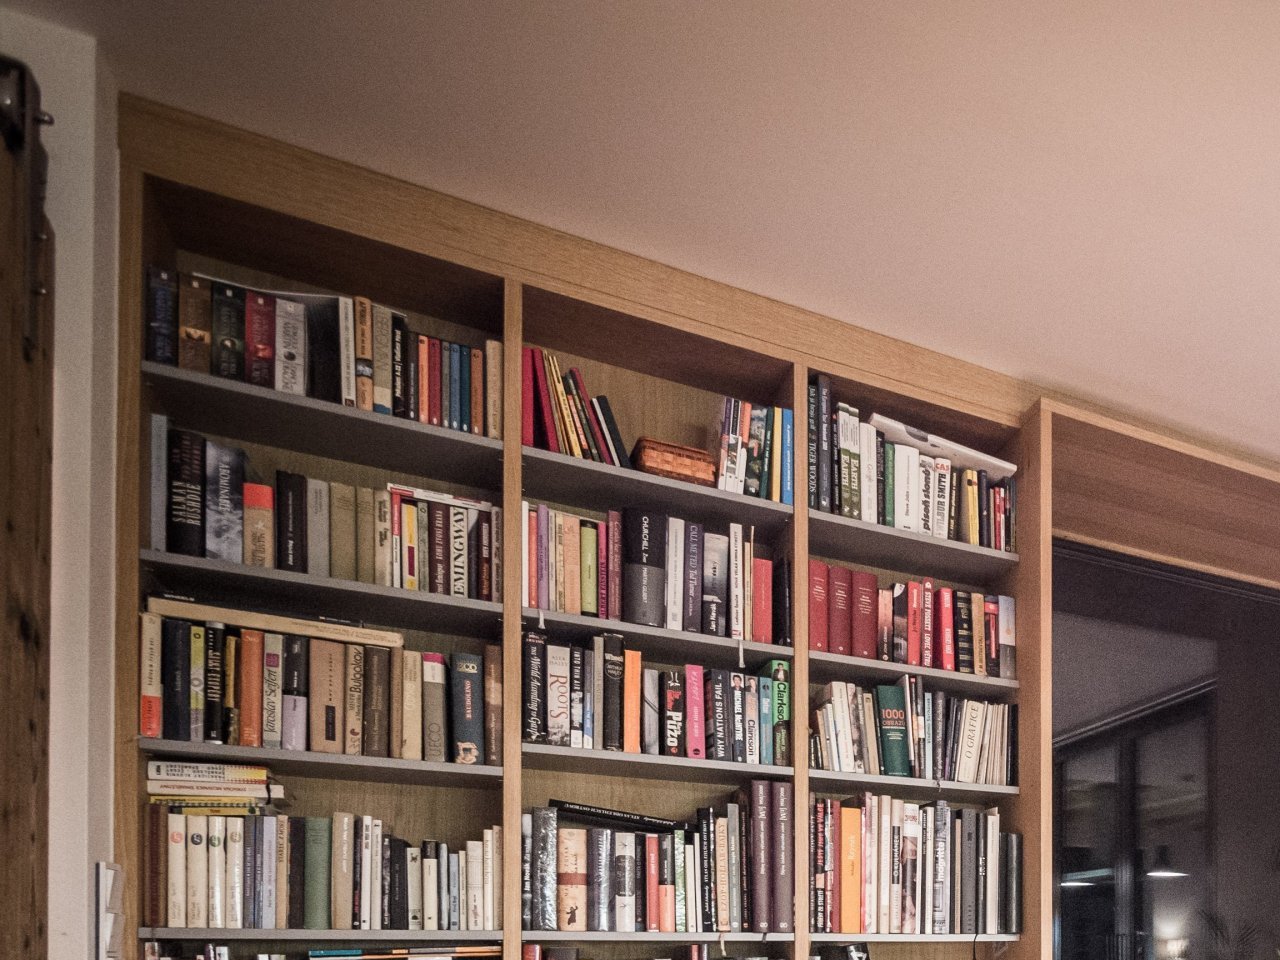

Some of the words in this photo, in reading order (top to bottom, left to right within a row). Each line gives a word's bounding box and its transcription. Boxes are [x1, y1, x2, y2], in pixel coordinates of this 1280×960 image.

[808, 441, 817, 464] TIGER
[808, 465, 817, 493] WOODS
[841, 453, 850, 486] EARTH
[850, 458, 859, 491] EARTH
[920, 469, 931, 500] slonů
[172, 480, 187, 523] SALMAN
[937, 473, 947, 500] SMITH
[186, 483, 202, 526] RUSHDIE
[920, 500, 931, 531] píseň
[641, 515, 650, 551] CHURCHILL
[689, 524, 699, 543] CALL
[689, 542, 698, 554] ME
[688, 568, 698, 580] Ted
[689, 553, 698, 569] TED
[349, 647, 363, 695] Bulgakov
[529, 656, 542, 678] World
[573, 651, 582, 665] INTO
[573, 665, 582, 680] THIN
[463, 680, 473, 719] BAUDOLINO
[527, 677, 541, 711] According
[548, 672, 569, 721] ROOTS
[714, 682, 723, 700] FAIL
[734, 690, 743, 714] MICHAEL
[776, 682, 787, 723] Clarkso
[264, 700, 277, 733] Jaroslav
[666, 710, 683, 747] Puzo
[715, 701, 724, 739] NATIONS
[881, 708, 905, 720] 1000
[965, 706, 980, 748] GRAFICE
[715, 740, 725, 758] WHY
[964, 750, 973, 759] O
[935, 841, 946, 882] magritte
